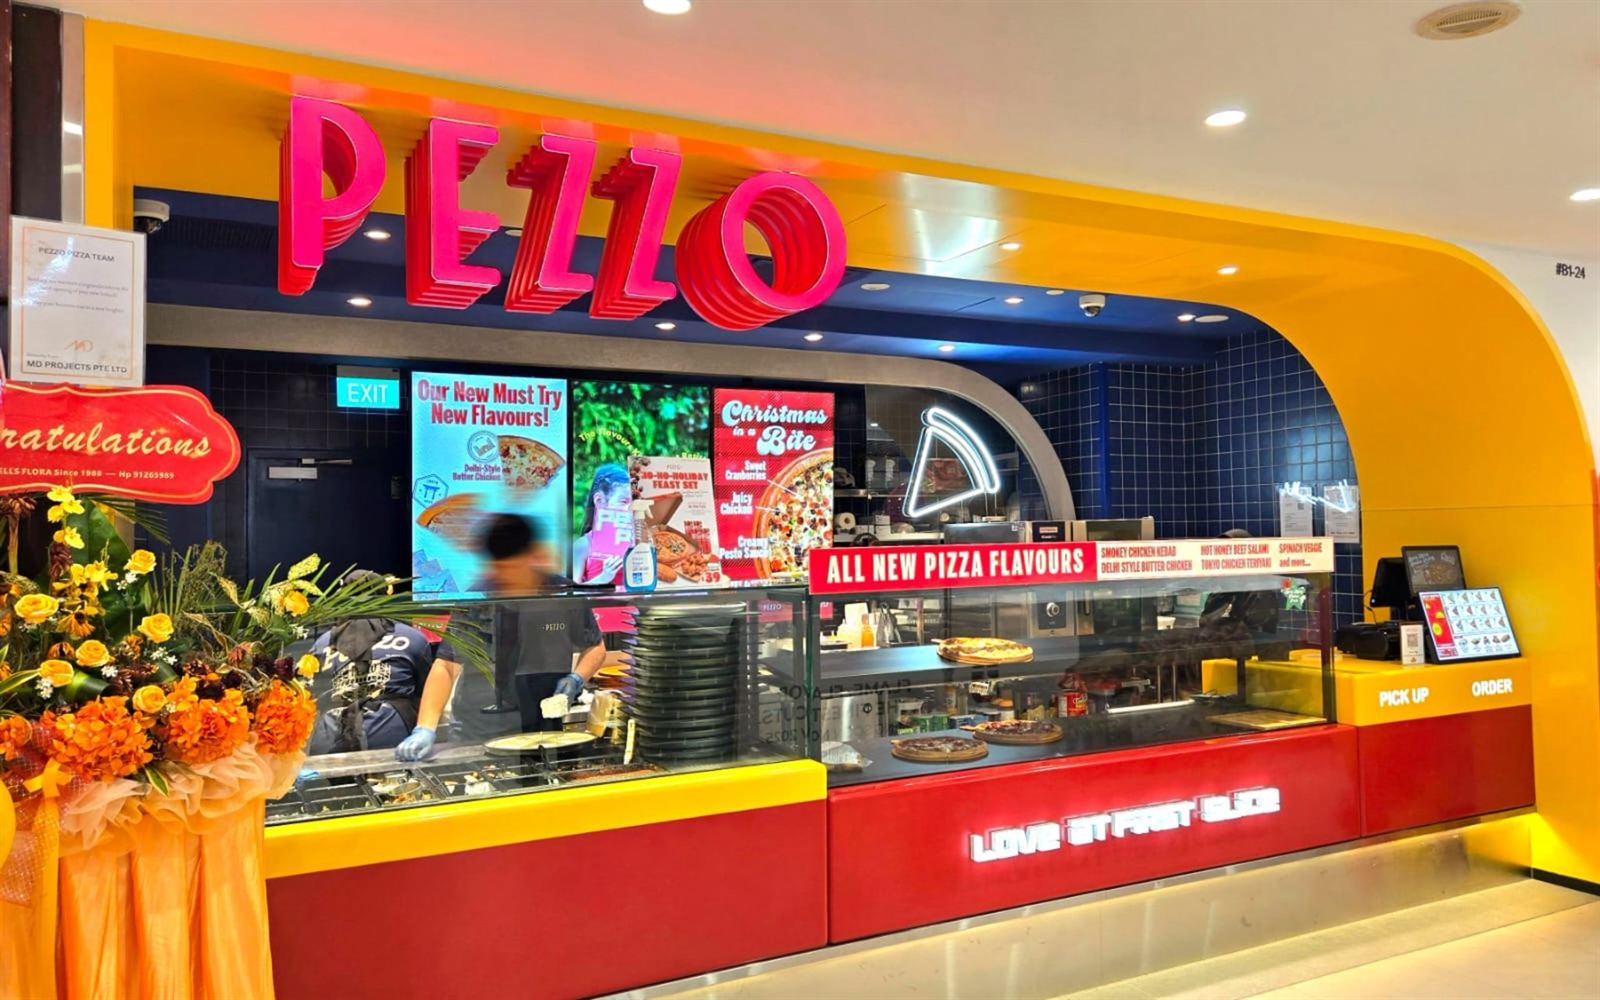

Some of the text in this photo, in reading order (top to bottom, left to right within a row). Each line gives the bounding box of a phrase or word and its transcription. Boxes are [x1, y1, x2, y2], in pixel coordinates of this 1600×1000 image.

[278, 94, 847, 331] PEZZO
[67, 249, 91, 260] PIZZA
[92, 252, 115, 262] TEAM
[1556, 262, 1585, 279] #B1-24
[26, 360, 43, 368] MD
[45, 360, 92, 371] PROJECTS
[93, 364, 109, 372] PTE
[348, 383, 388, 403] EXIT
[417, 379, 562, 411] Our New Must Try
[432, 403, 548, 427] New Flavours!
[722, 400, 828, 426] Christmas
[733, 425, 816, 456] in a Bite
[22, 467, 52, 476] FLORA
[54, 468, 79, 477] Since
[119, 471, 131, 479] Hp
[653, 480, 699, 489] FEAST SET
[1101, 545, 1176, 558] SMOKEY CHICKEN KEBAB
[1200, 543, 1269, 555] HOT HONEY BEEF SALAMI
[1279, 542, 1322, 553] SPINACH VEGGIE
[827, 548, 1084, 584] ALL NEW PIZZA FLAVOURS
[1101, 560, 1192, 573] DELHI STYLE BUTTER CHICKEN
[1201, 559, 1220, 570] TOKYO
[1221, 558, 1246, 569] CHICKEN
[1280, 557, 1290, 567] and
[1472, 678, 1513, 697] ORDER
[1379, 687, 1429, 708] PICK UP
